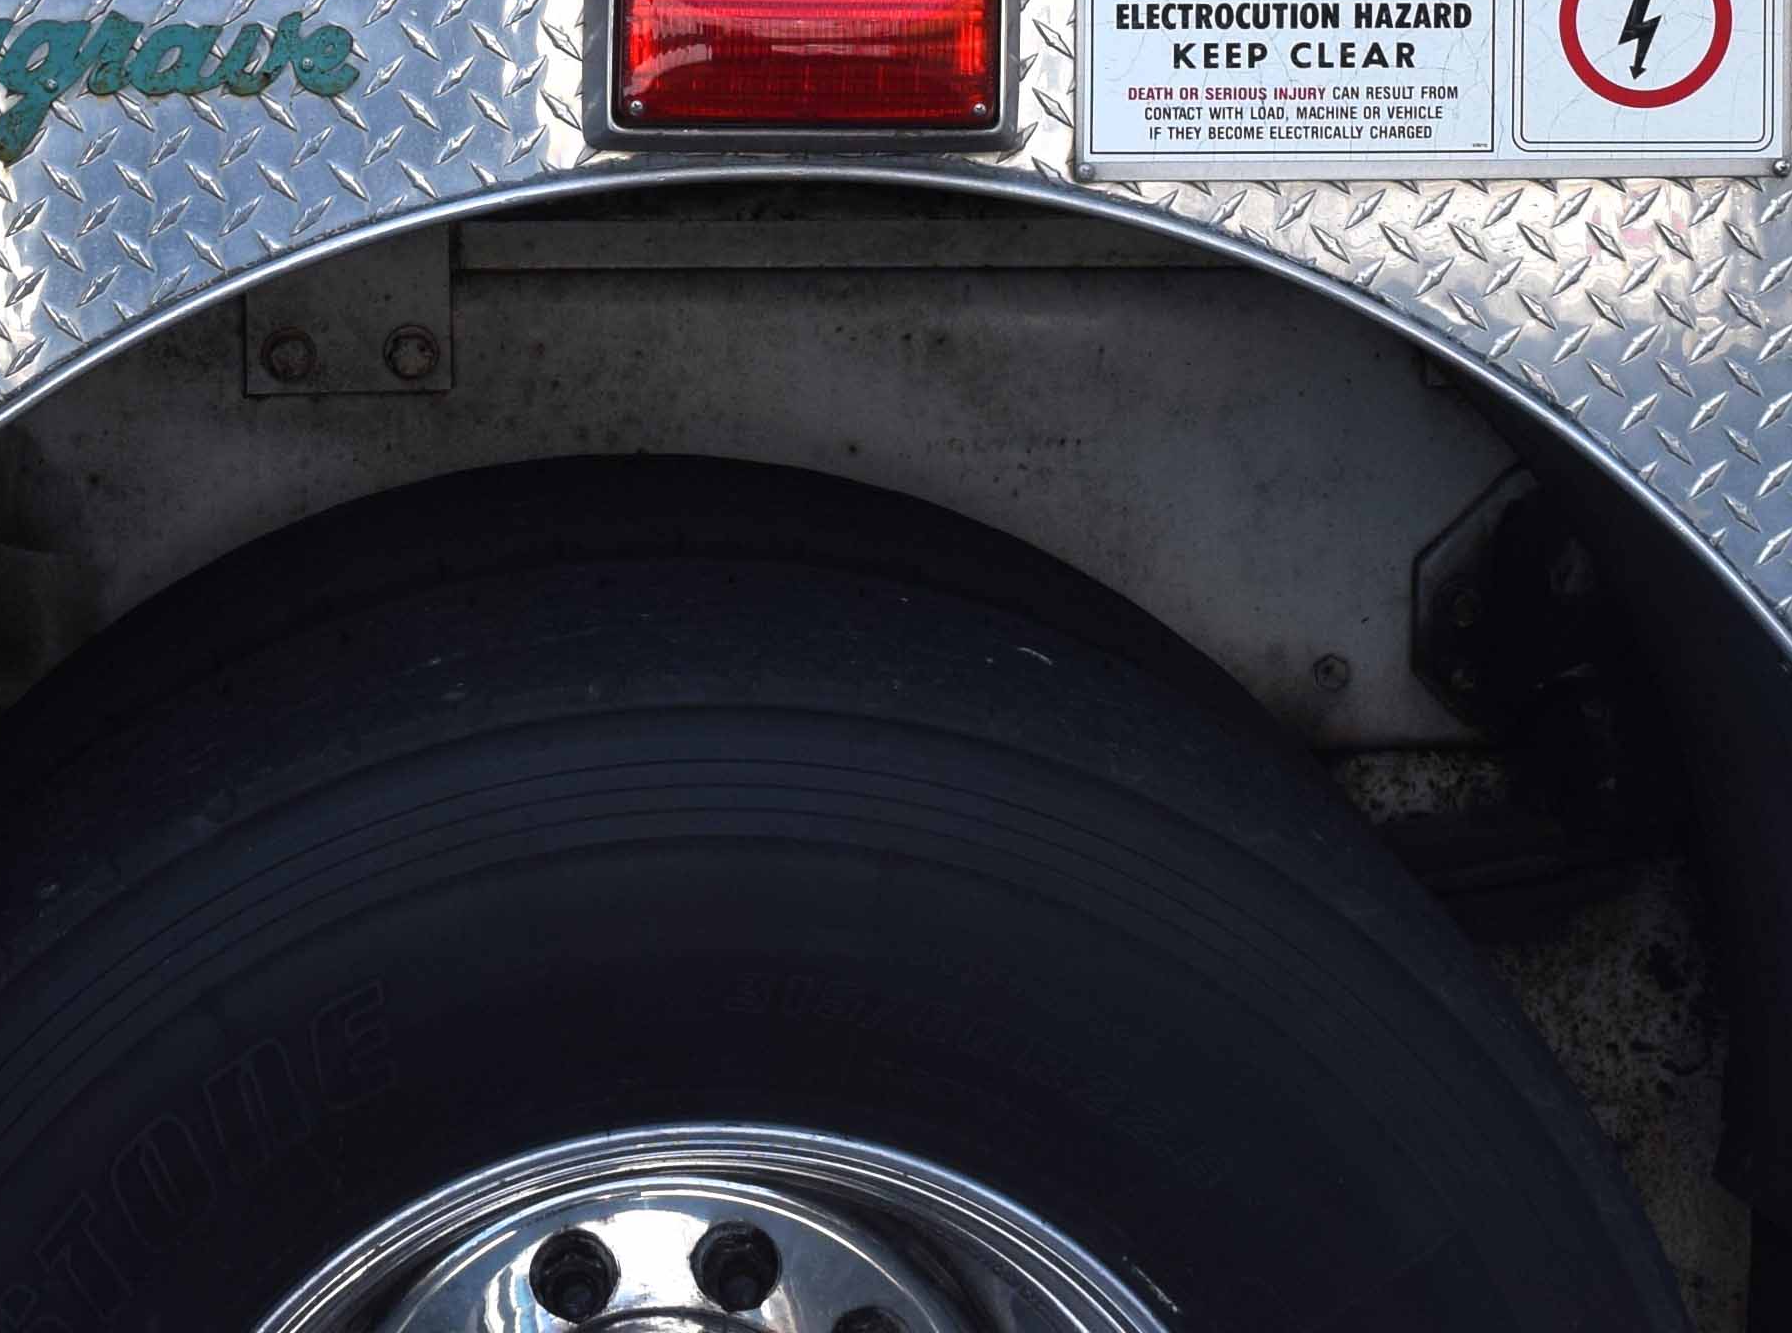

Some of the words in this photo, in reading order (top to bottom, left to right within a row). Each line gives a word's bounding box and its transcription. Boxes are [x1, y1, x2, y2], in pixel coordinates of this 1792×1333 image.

[1115, 2, 1340, 30] ELECTROCUTION
[1354, 2, 1472, 29] HAZARD
[1173, 42, 1267, 69] KEEP
[1290, 42, 1415, 69] CLEAR
[1128, 87, 1173, 101] DEATH
[1179, 87, 1199, 101] OR
[1205, 87, 1267, 101] SERIOUS
[1273, 87, 1326, 100] INJURY
[1332, 86, 1360, 100] CAN
[1366, 86, 1414, 100] RESULT
[1420, 86, 1458, 100] FROM
[1144, 106, 1203, 121] CONTACT
[1209, 106, 1244, 121] WITH
[1250, 106, 1289, 122] LOAD,
[1296, 106, 1358, 120] MACHINE
[1363, 106, 1381, 120] OR
[1387, 106, 1443, 120] VEHICLE
[1149, 126, 1162, 140] IF
[1167, 126, 1202, 140] THEY
[1208, 126, 1264, 140] BECOME
[1269, 126, 1364, 140] ELECTRICALLY
[1369, 126, 1433, 140] CHARGED
